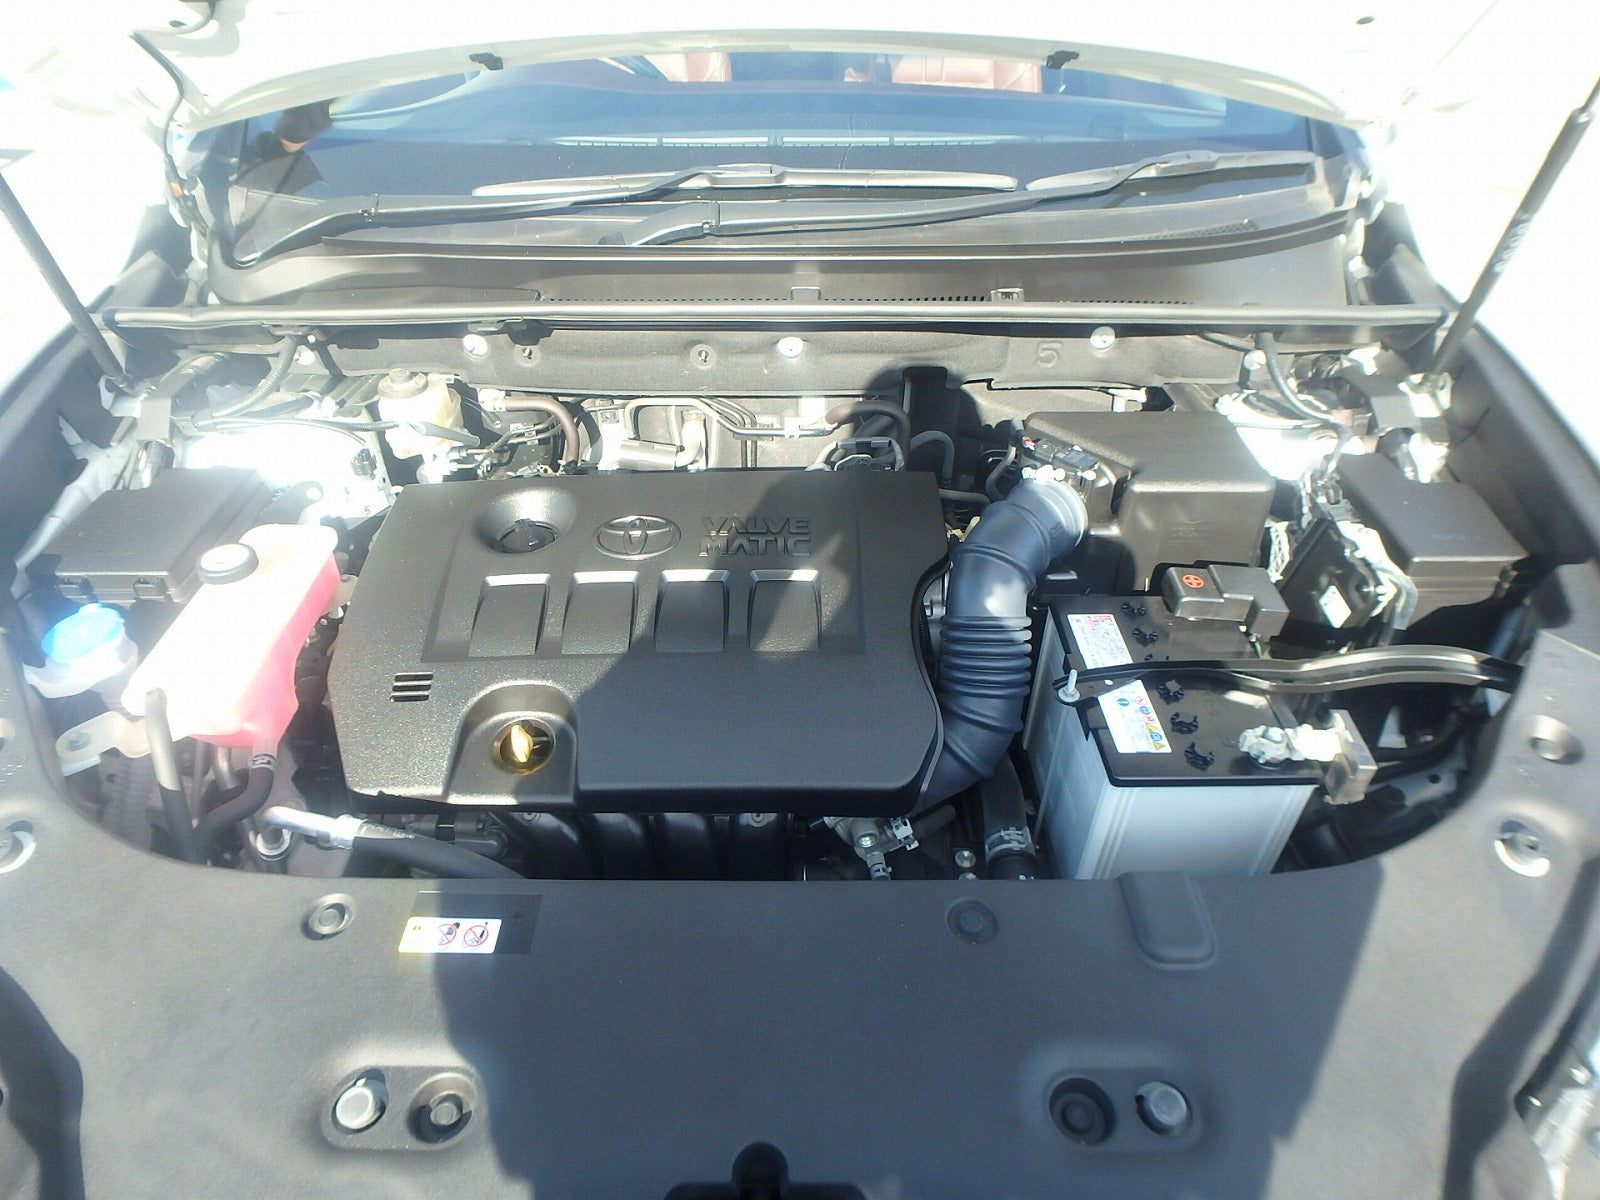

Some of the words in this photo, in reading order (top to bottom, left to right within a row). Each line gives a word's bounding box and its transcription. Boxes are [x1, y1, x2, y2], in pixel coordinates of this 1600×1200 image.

[1036, 340, 1063, 368] 5
[701, 516, 811, 536] VALVE
[699, 536, 811, 557] MATIC
